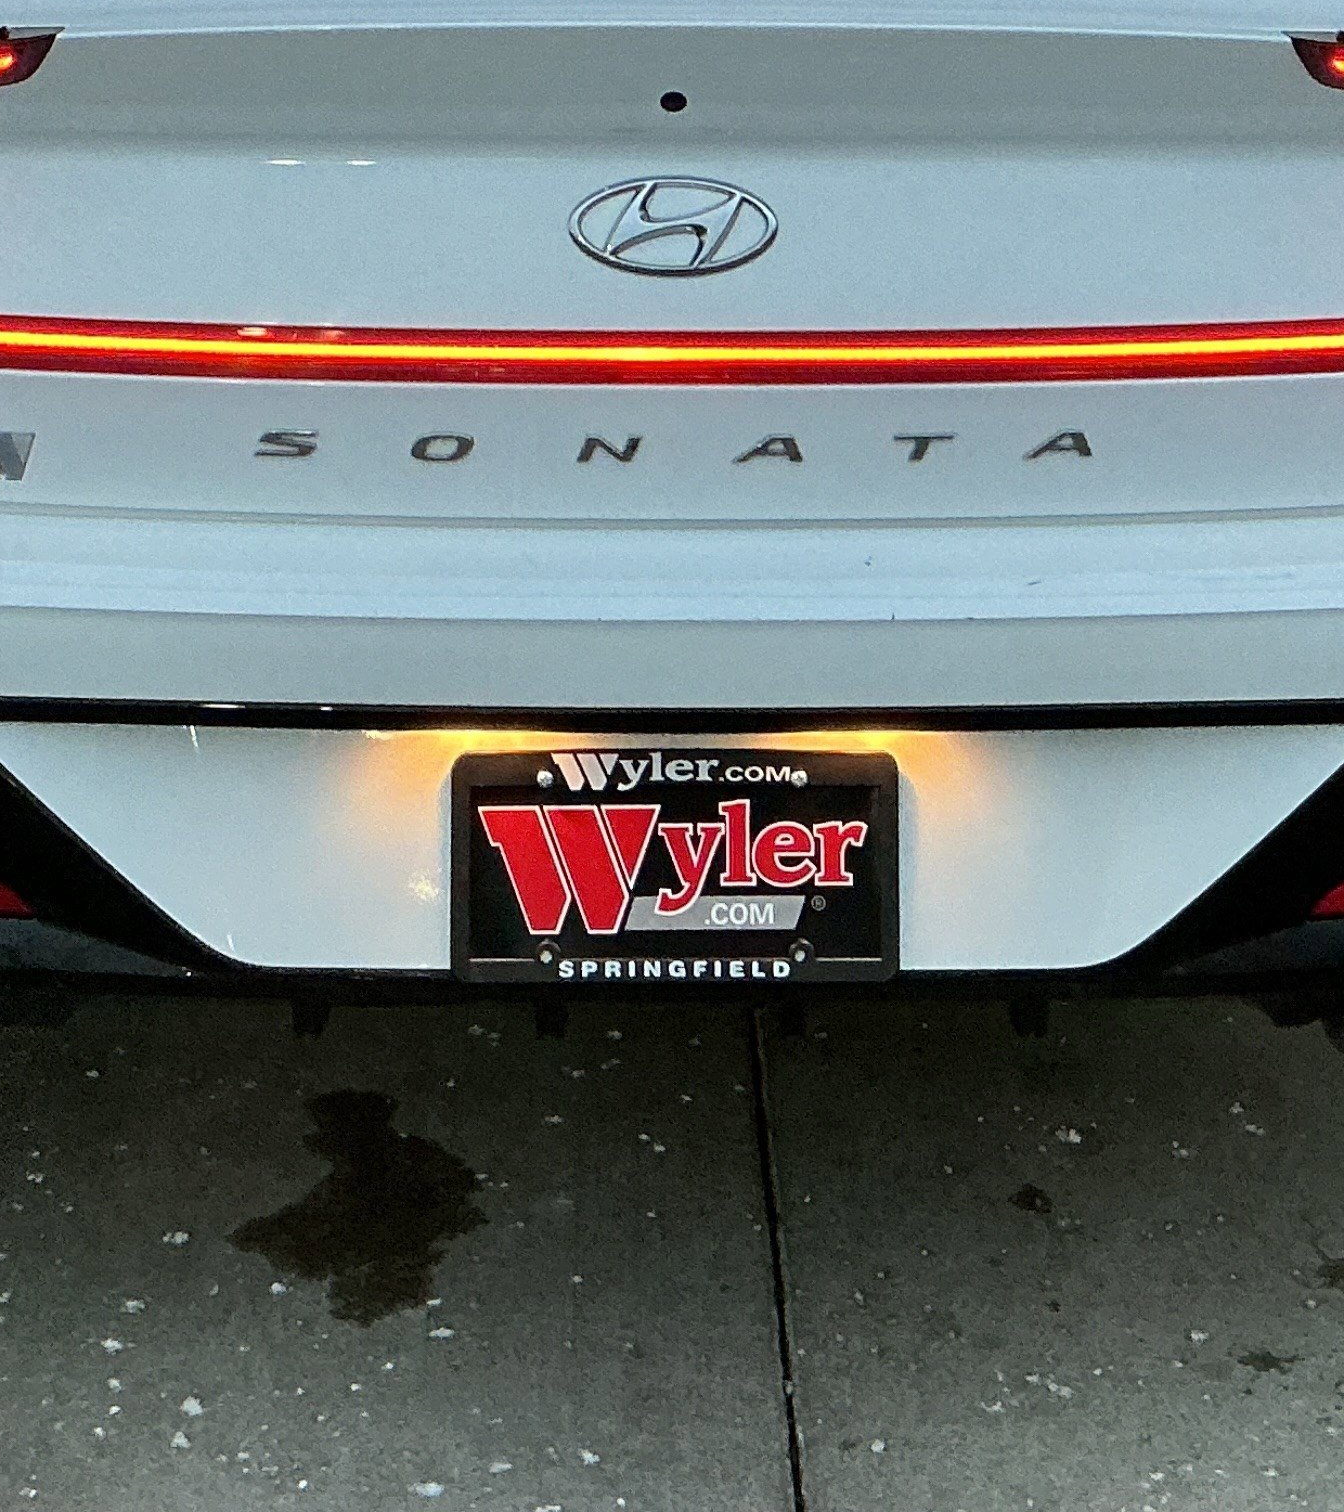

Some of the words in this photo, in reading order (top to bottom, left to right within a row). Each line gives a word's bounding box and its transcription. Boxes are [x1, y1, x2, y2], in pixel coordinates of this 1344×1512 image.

[254, 429, 1093, 464] SONATA
[478, 799, 867, 934] Wyler
[558, 959, 791, 979] SPRINGFIELD
